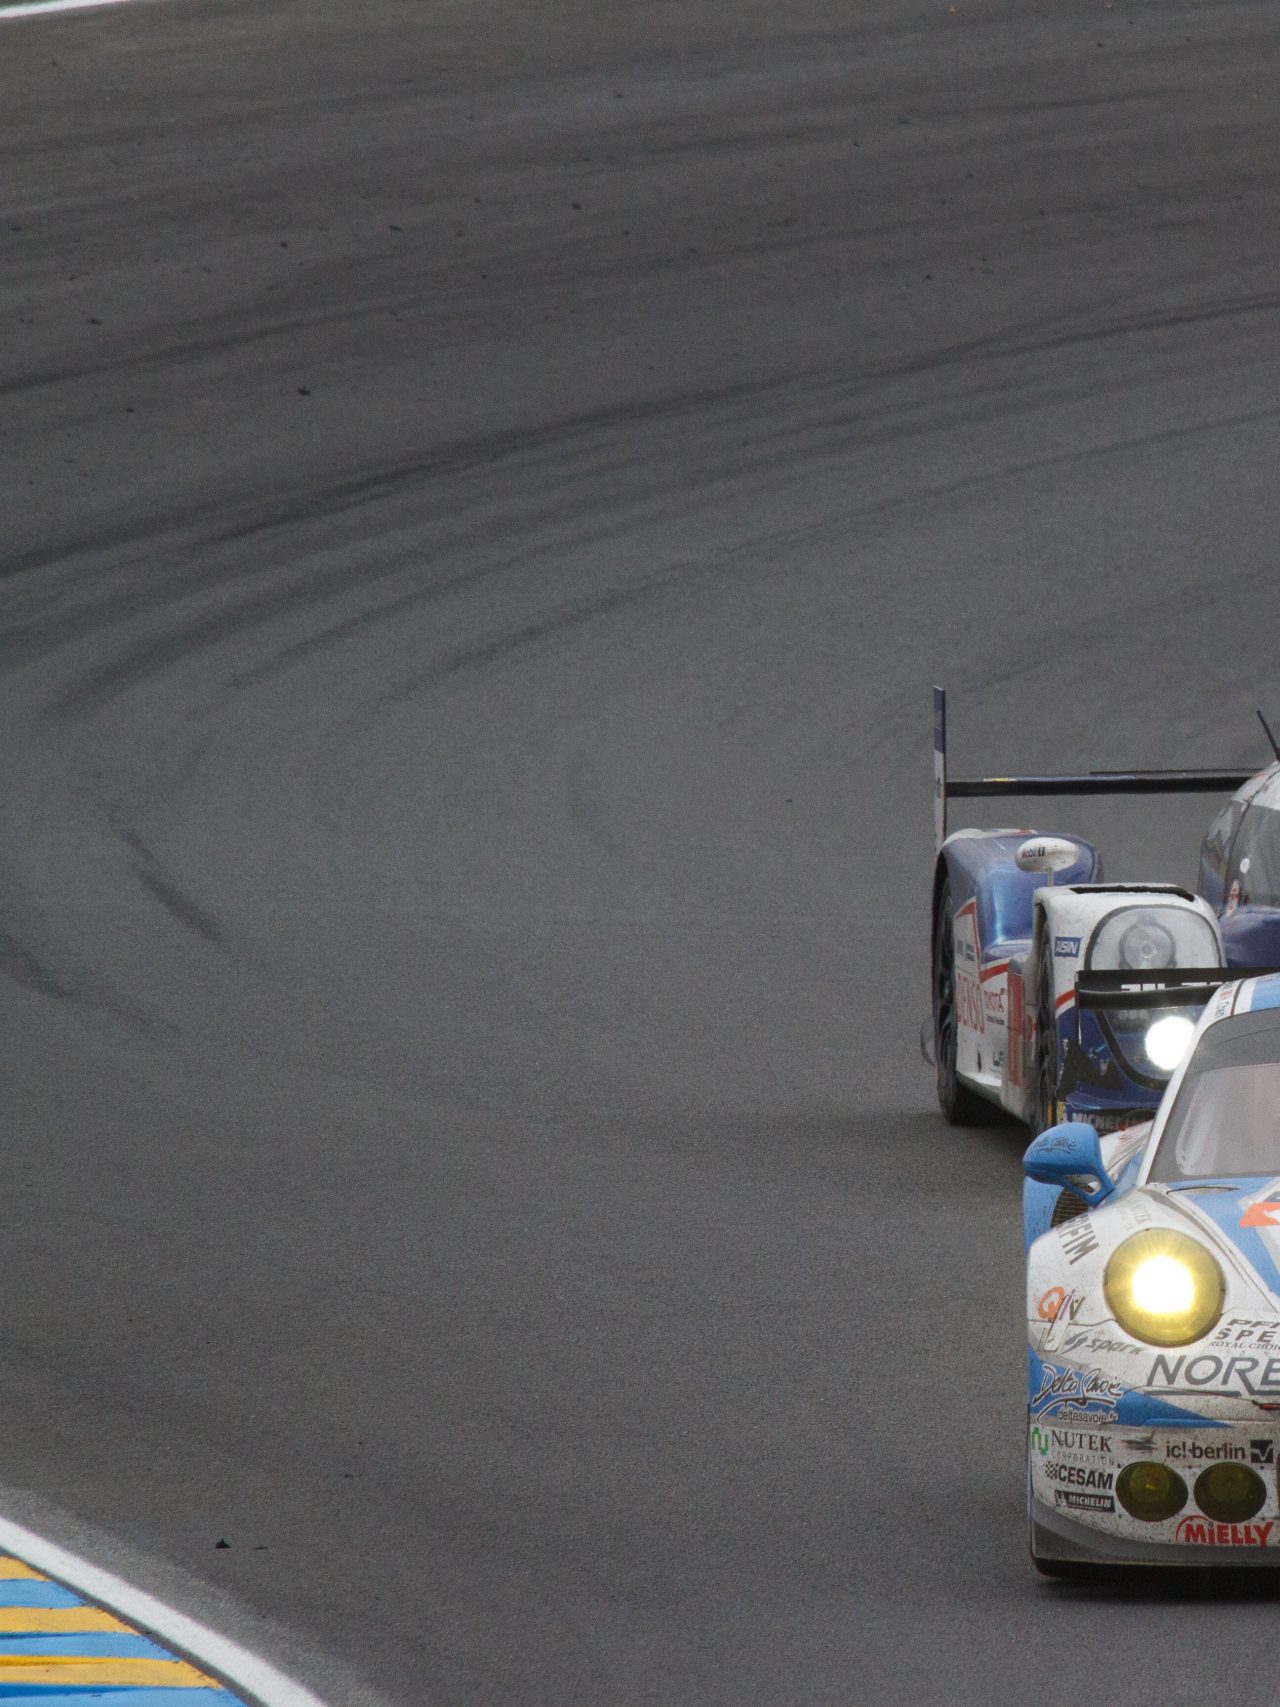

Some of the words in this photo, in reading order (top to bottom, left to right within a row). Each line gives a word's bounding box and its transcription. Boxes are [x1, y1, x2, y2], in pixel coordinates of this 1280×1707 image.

[1208, 1341, 1245, 1349] ROYAL
[1051, 1430, 1112, 1453] NUTEK
[1192, 1441, 1246, 1460] berlin
[1058, 1464, 1114, 1490] CESAM
[1068, 1494, 1112, 1508] MICHELIN
